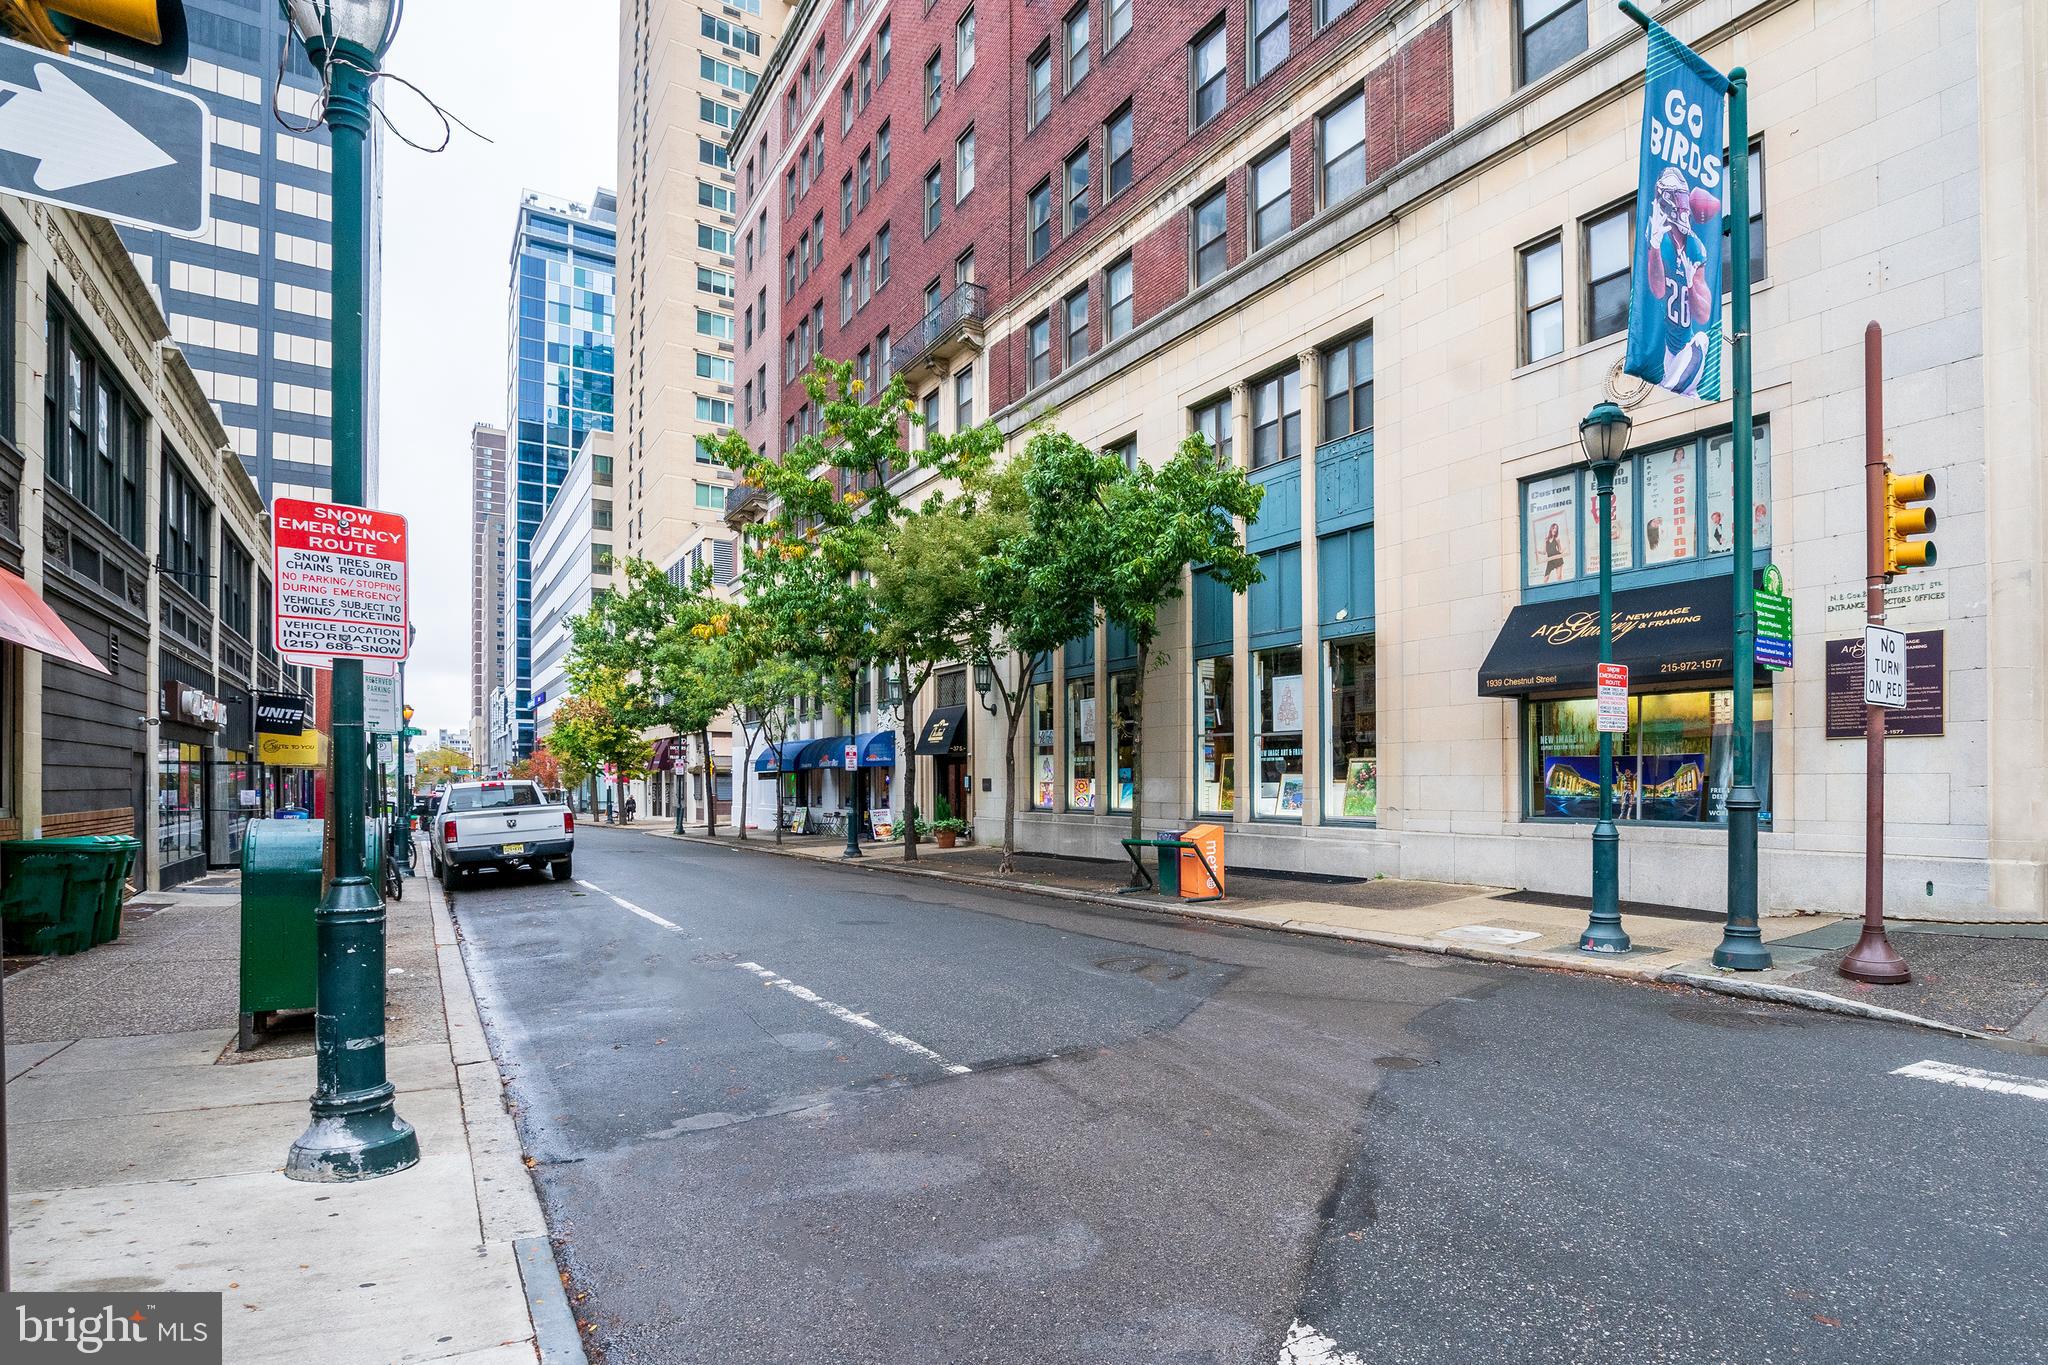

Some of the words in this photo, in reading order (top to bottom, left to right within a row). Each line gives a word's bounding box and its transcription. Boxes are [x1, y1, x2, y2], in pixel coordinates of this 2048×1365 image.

[1664, 89, 1703, 139] GO
[1650, 115, 1722, 188] BIRDS
[1665, 276, 1692, 328] 26
[313, 507, 373, 526] SNOW
[278, 517, 402, 545] EMERGENCY
[309, 536, 377, 556] ROUTE
[286, 560, 334, 573] CHAINS
[340, 566, 398, 581] REQUIRED
[293, 552, 330, 564] SNOW
[336, 557, 370, 569] TIRES
[376, 562, 392, 572] OR
[282, 571, 297, 581] NO
[302, 573, 347, 586] PARKING
[356, 579, 402, 593] STOPPING
[282, 582, 327, 595] DURING
[333, 587, 401, 602] EMERGENCY
[283, 594, 336, 607] VEHICLES
[340, 600, 386, 612] SUBJECT
[389, 605, 402, 614] TO
[1827, 601, 1866, 613] ENTRANCE
[1883, 596, 1912, 606] OCTORS
[1914, 592, 1946, 602] OFFICES
[284, 603, 332, 616] TOWING
[343, 609, 401, 623] TICKETING
[1625, 612, 1653, 621] NEW
[1653, 606, 1692, 618] IMAGE
[1647, 615, 1702, 628] FRAMING
[285, 620, 337, 632] VEHICLE
[342, 625, 400, 637] LOCATION
[284, 639, 319, 649] (215)
[325, 642, 400, 654] 686-SNOW
[1881, 637, 1896, 654] NO
[1660, 658, 1723, 673] 215-972-1577
[1875, 658, 1899, 675] TURN
[1486, 679, 1503, 688] 1939
[1503, 676, 1534, 686] Chestnut
[1535, 675, 1557, 684] Street
[1600, 673, 1627, 681] EMERGENCY
[367, 684, 391, 694] PARKING
[1869, 679, 1882, 694] ON
[1886, 682, 1903, 698] RED
[257, 706, 304, 720] UNITE
[1540, 735, 1554, 744] NEW
[1556, 734, 1577, 743] IMAGE
